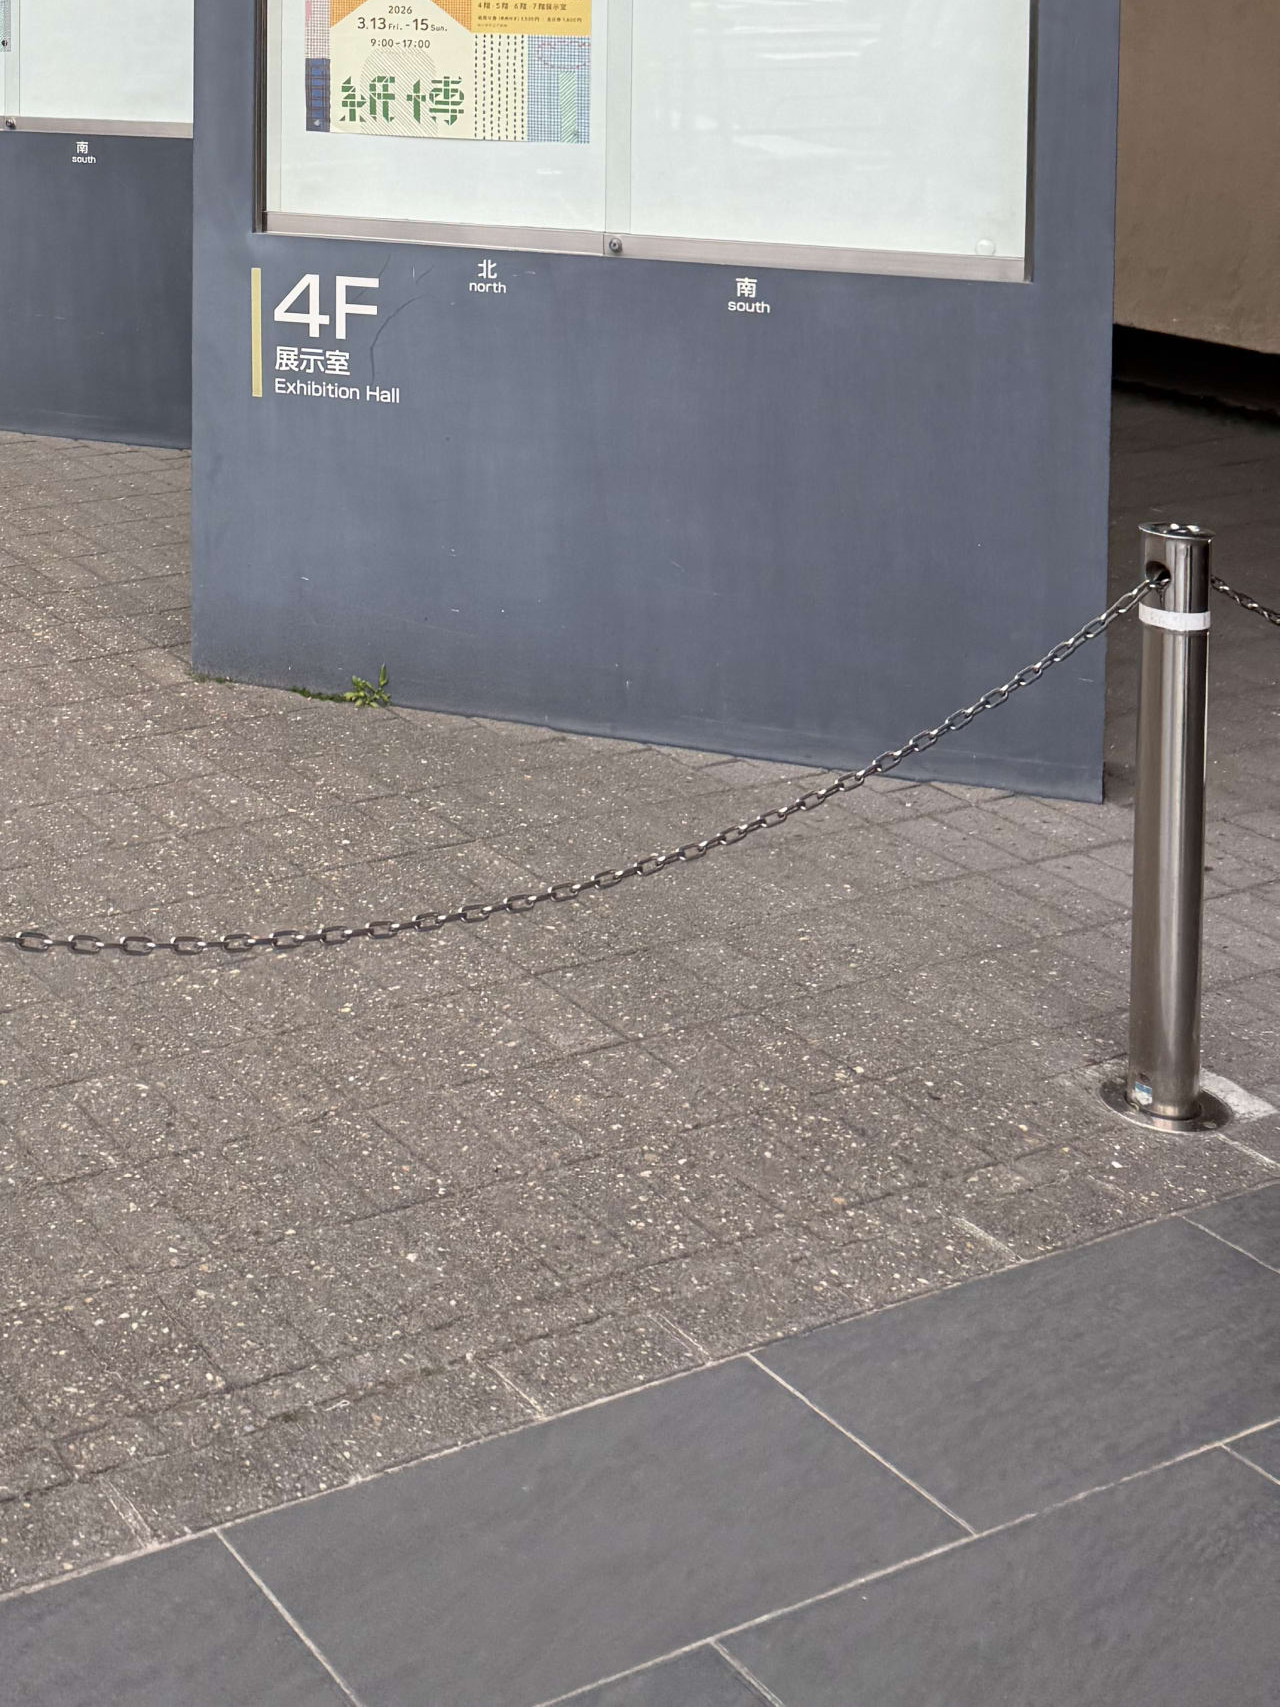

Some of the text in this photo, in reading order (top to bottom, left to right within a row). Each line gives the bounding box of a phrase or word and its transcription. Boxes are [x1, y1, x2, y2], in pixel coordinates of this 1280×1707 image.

[387, 5, 413, 15] 2026
[339, 75, 465, 126] 紙博
[75, 141, 89, 154] 南
[71, 155, 96, 164] south
[477, 259, 497, 280] 北
[469, 281, 507, 294] north
[735, 277, 758, 299] 南
[273, 273, 380, 340] 4F
[727, 300, 771, 314] south
[274, 345, 351, 376] 展示室
[274, 378, 400, 404] Exhibition Hall
